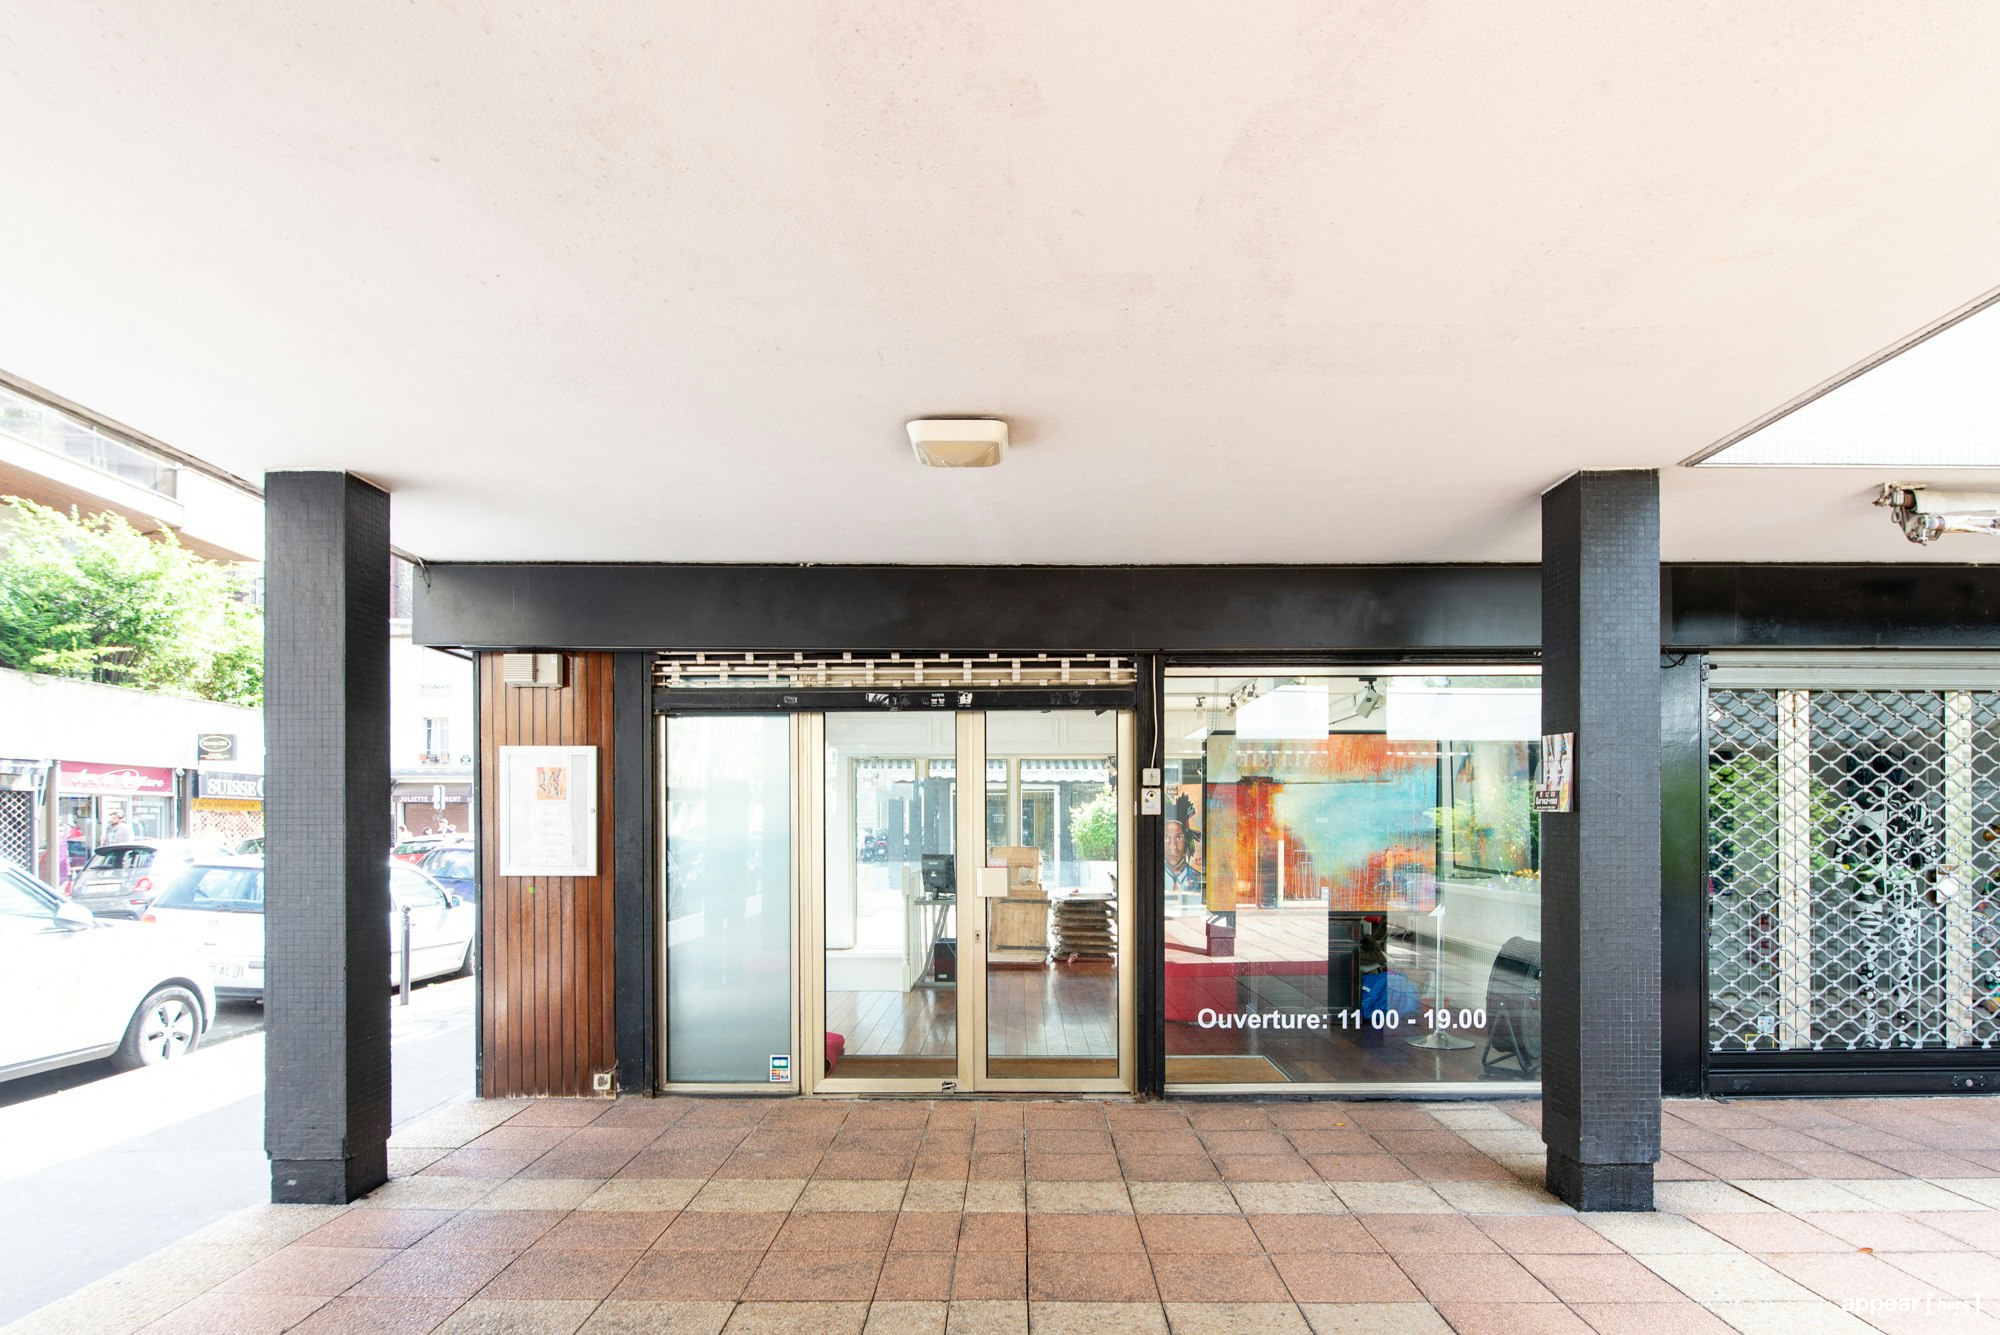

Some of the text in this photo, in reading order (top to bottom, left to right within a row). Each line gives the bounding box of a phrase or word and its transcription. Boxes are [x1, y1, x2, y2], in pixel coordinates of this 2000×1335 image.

[207, 779, 257, 797] SUISSE
[1197, 1008, 1328, 1029] Ouverture:
[1337, 1009, 1361, 1029] 11
[1371, 1009, 1399, 1029] 00
[1423, 1008, 1487, 1029] 19.00
